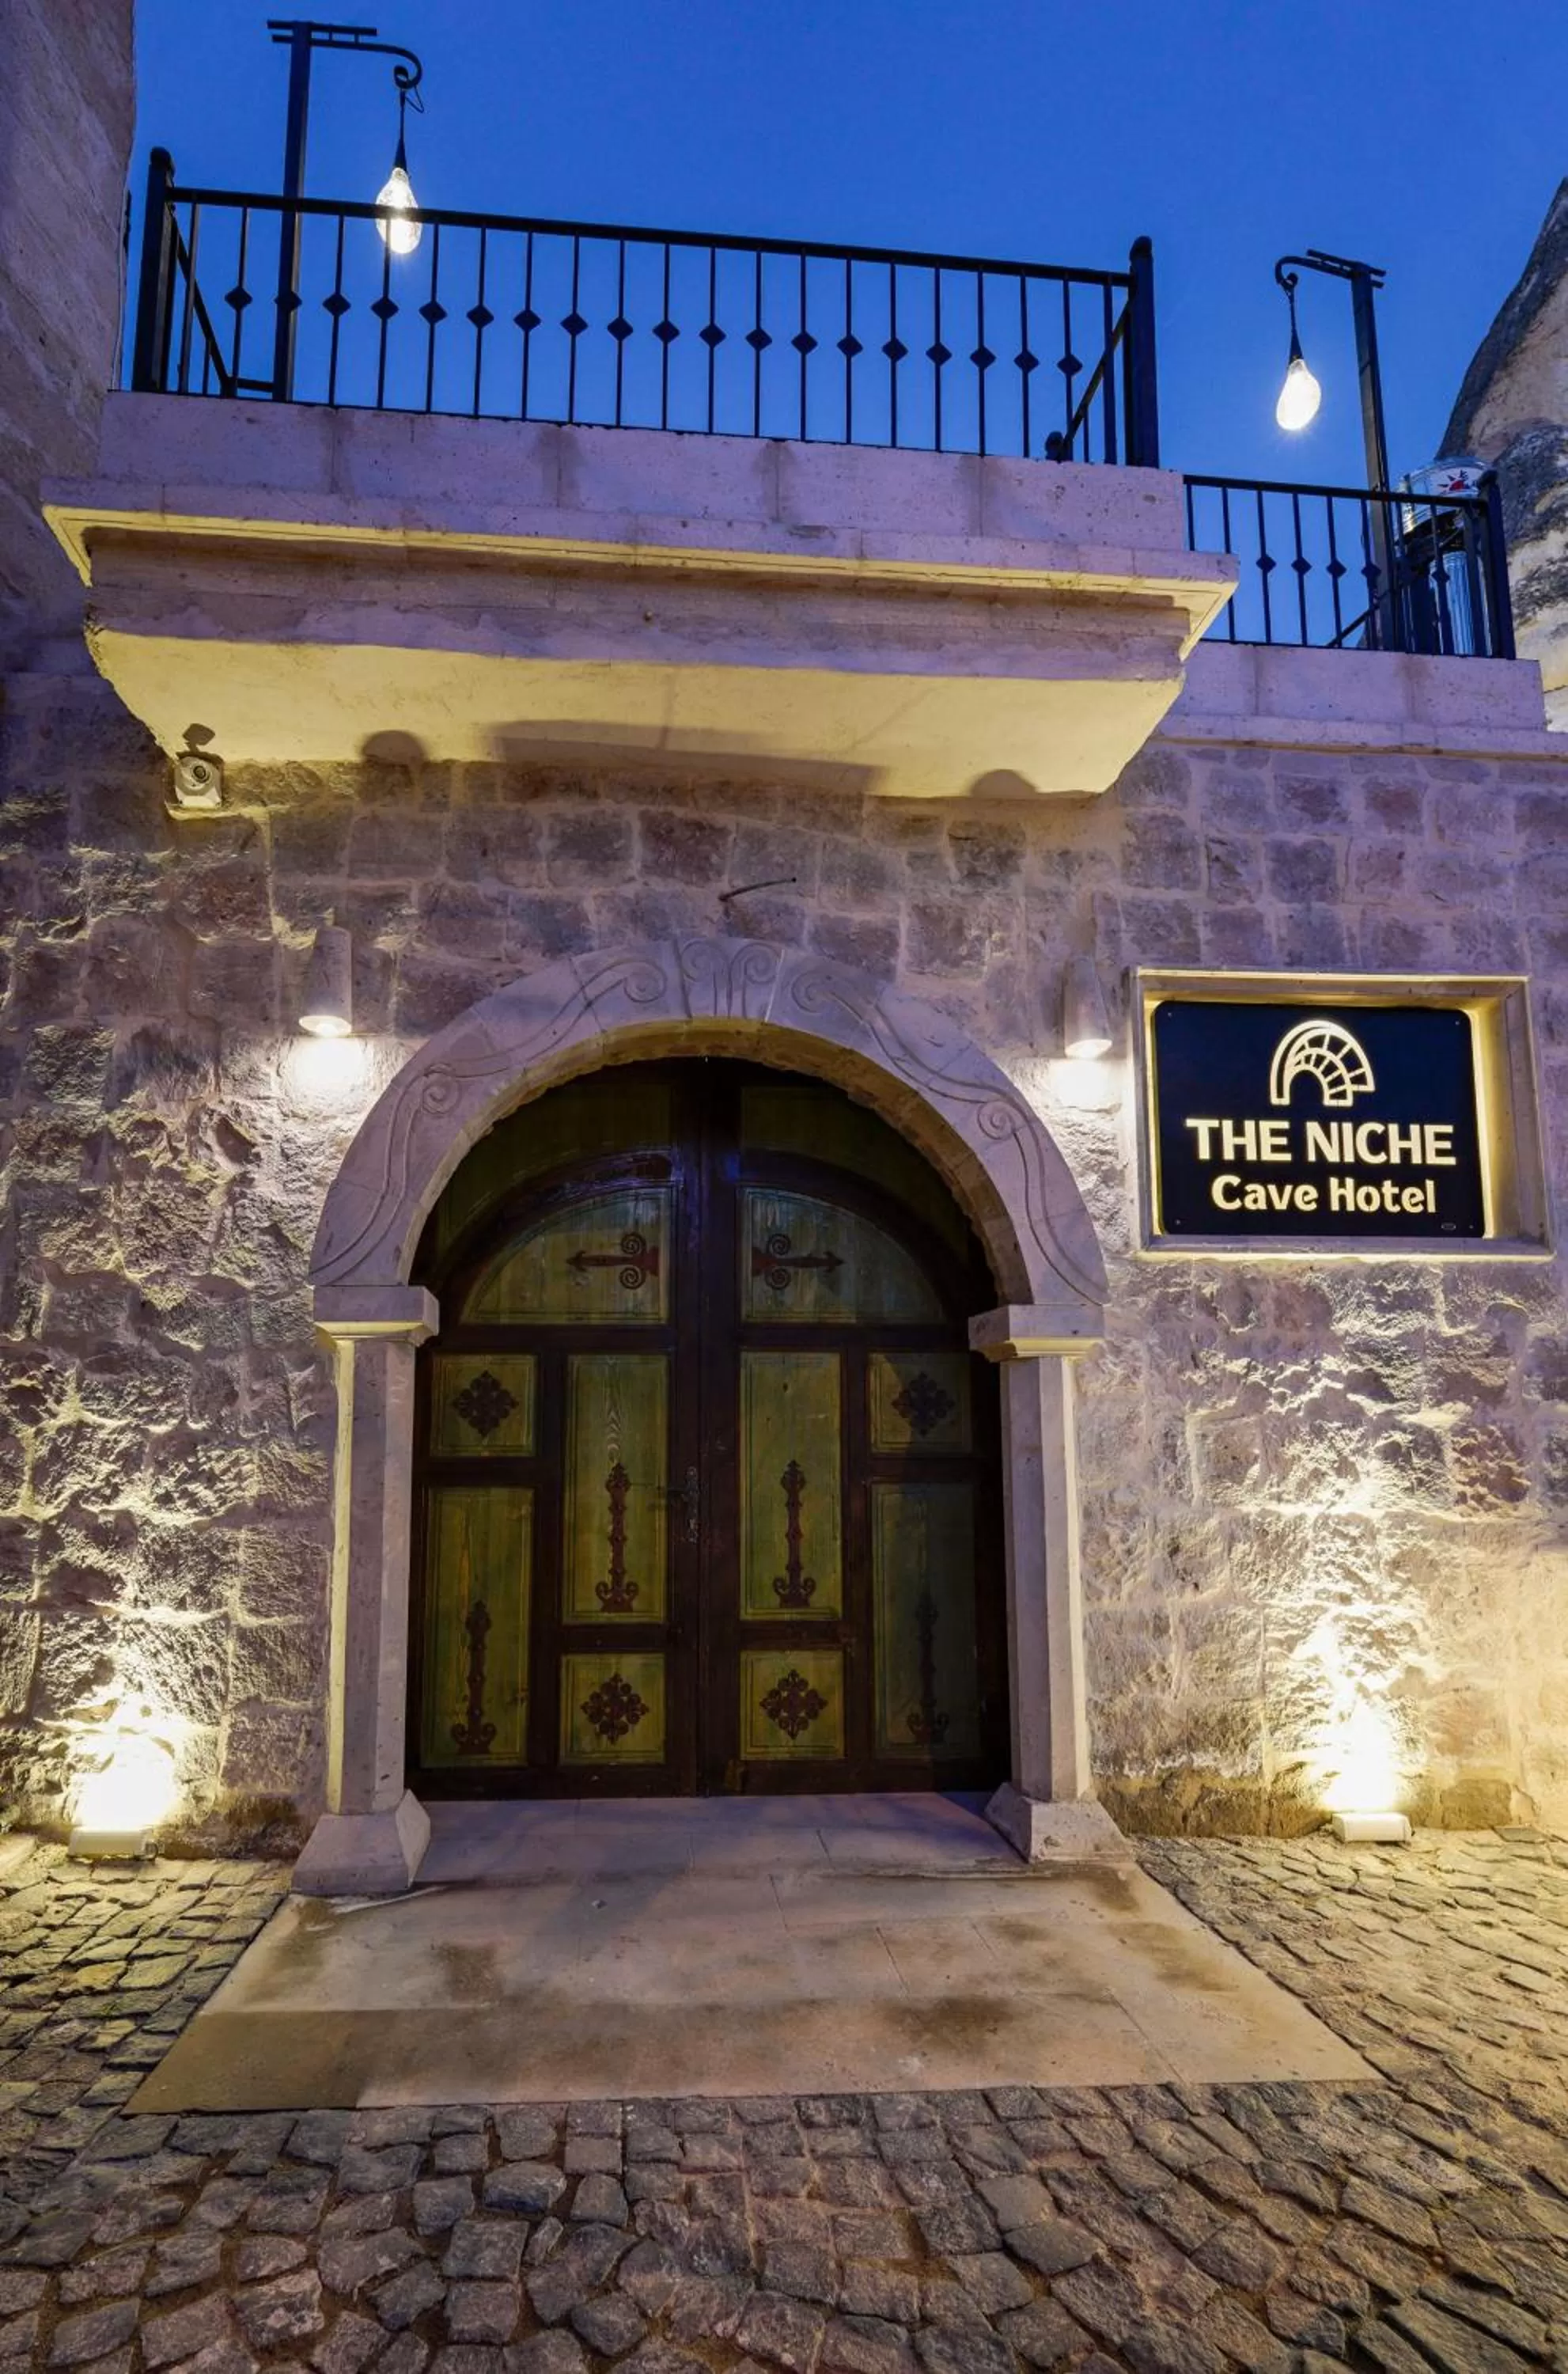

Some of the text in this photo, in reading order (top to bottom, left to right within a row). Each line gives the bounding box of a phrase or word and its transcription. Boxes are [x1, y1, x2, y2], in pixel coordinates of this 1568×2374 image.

[1185, 1118, 1456, 1165] THE NICHE
[1211, 1174, 1436, 1213] Cave Hotel
